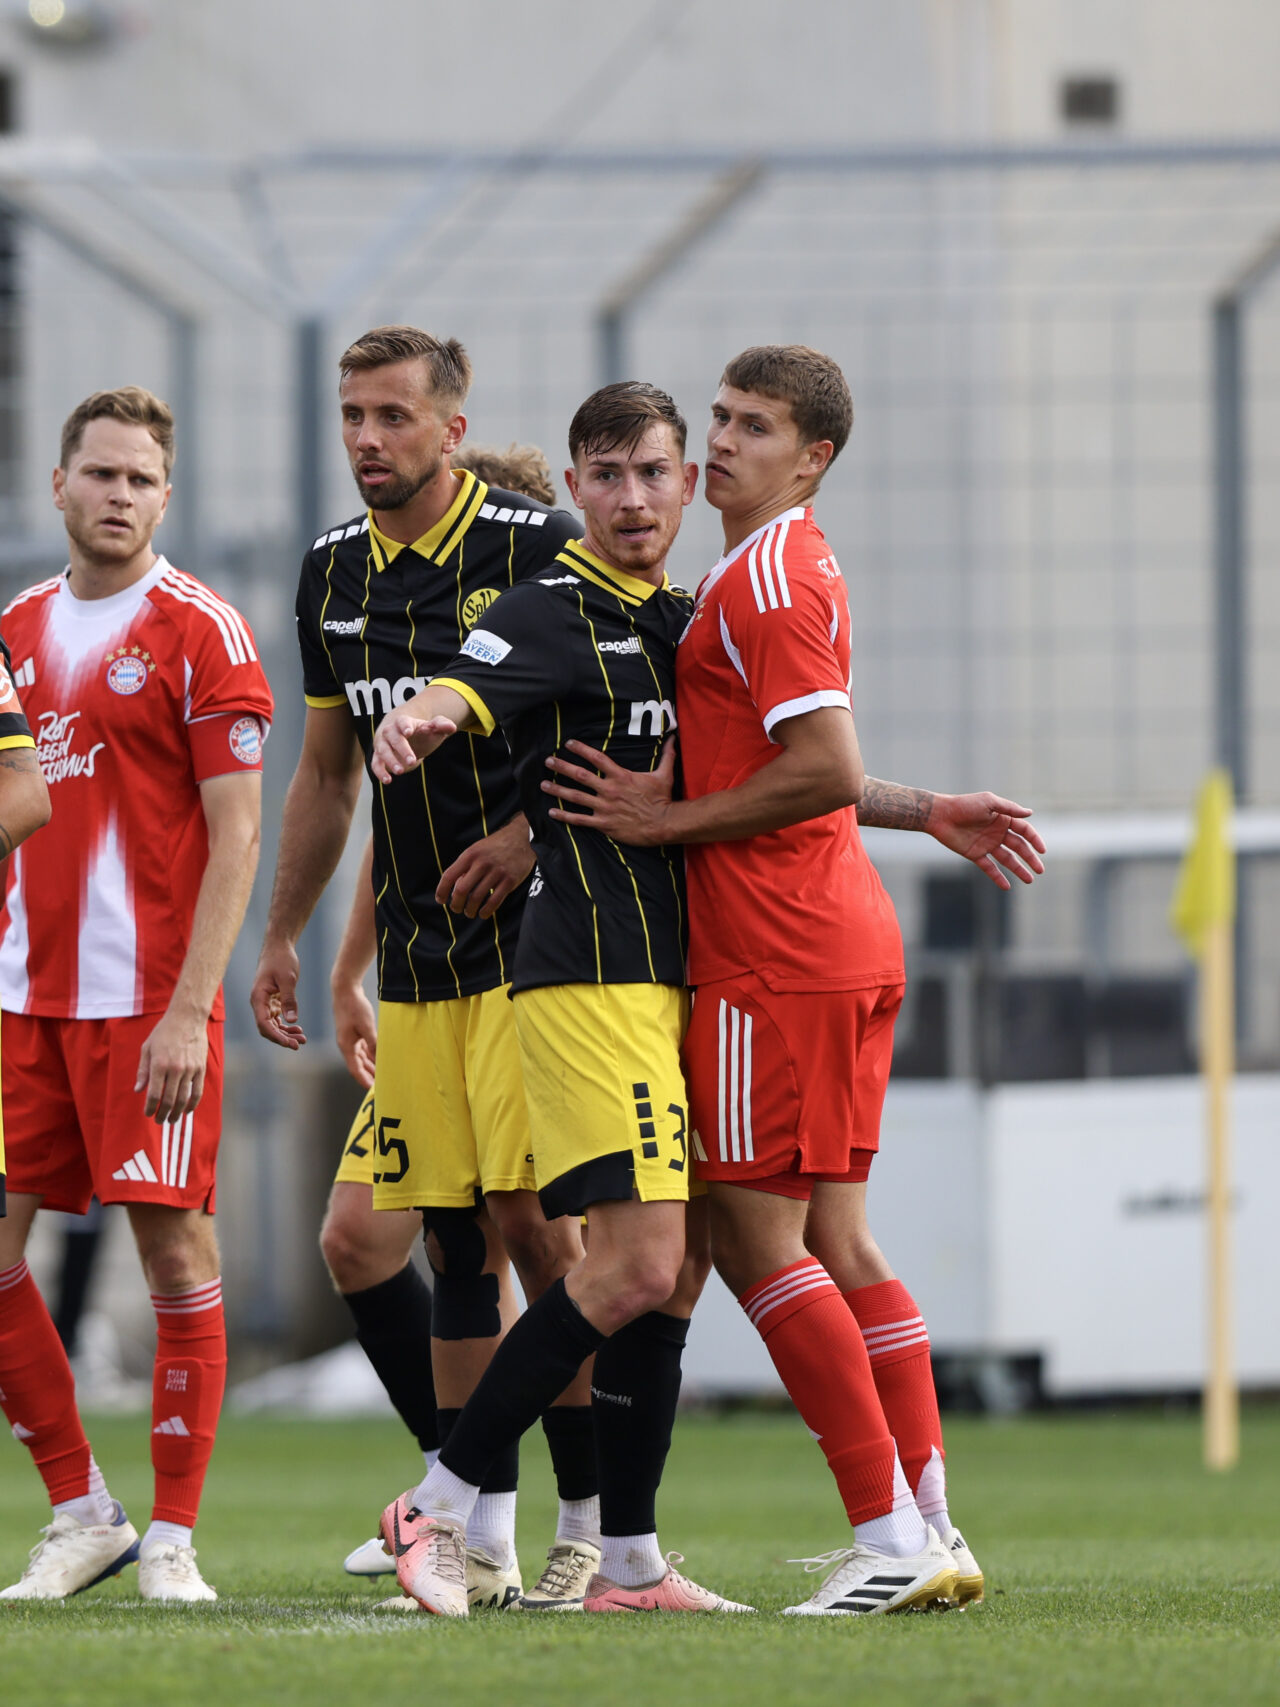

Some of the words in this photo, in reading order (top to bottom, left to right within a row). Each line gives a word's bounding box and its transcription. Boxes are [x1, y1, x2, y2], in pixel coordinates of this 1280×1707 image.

[323, 617, 364, 634] capelli
[598, 637, 640, 654] capelli
[345, 676, 434, 717] ma
[36, 727, 74, 762] GEGEN
[38, 711, 81, 744] ROT
[667, 1102, 687, 1173] 3
